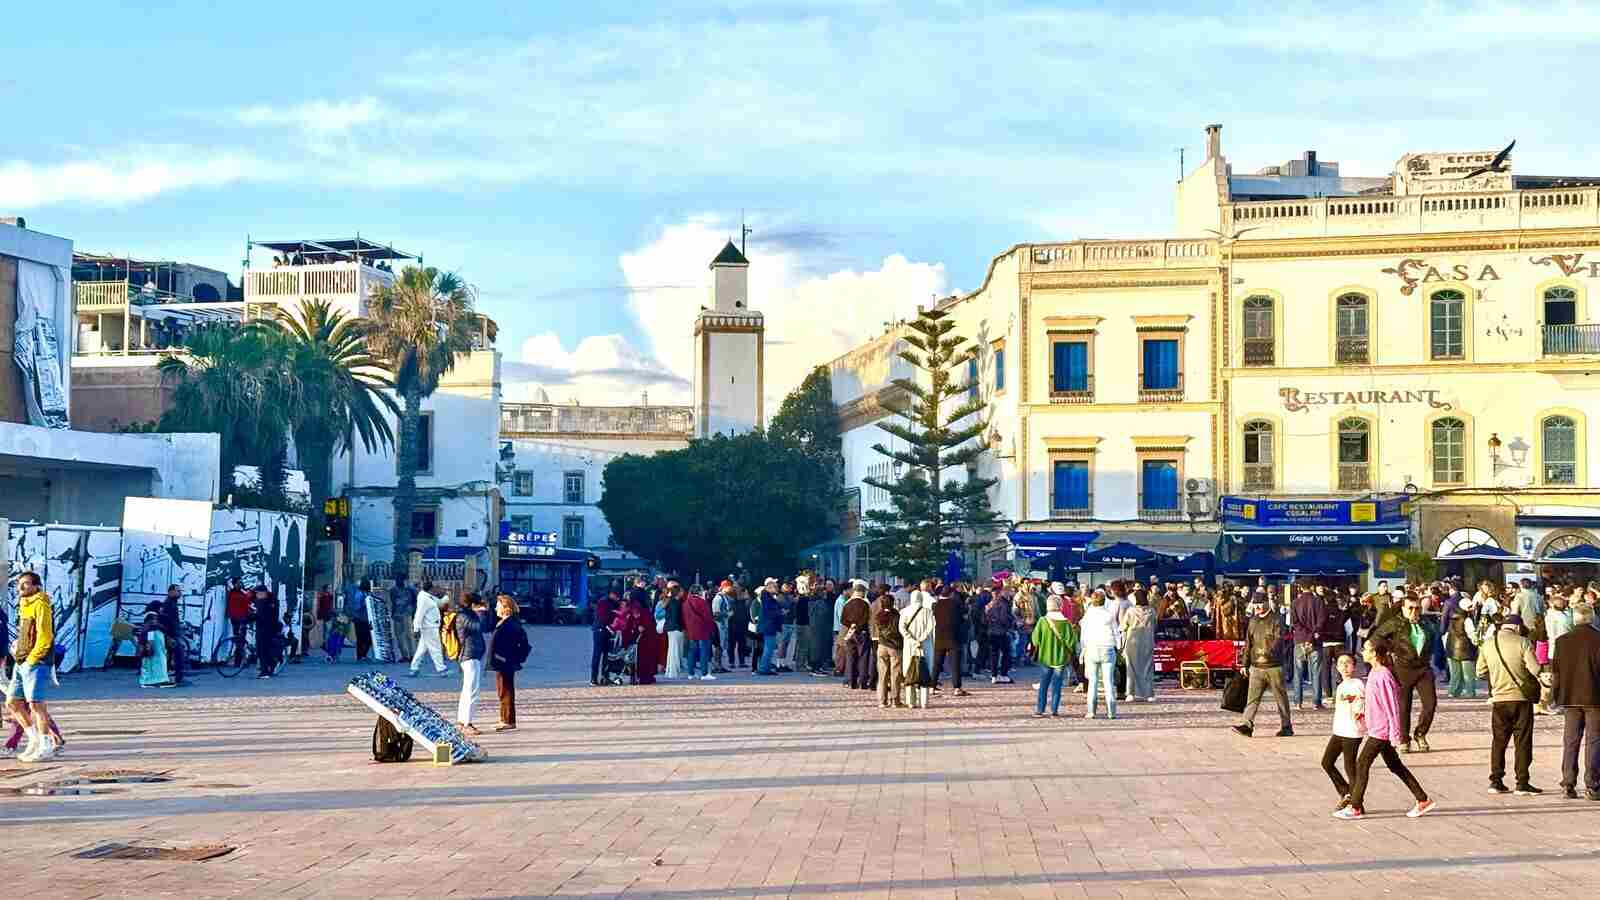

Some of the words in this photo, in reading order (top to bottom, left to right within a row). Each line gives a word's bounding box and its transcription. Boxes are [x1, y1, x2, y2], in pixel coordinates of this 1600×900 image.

[1386, 259, 1501, 291] CASA
[1538, 253, 1600, 278] VE
[1280, 388, 1448, 411] RESTAURANT
[1289, 503, 1340, 511] RESTAURANT
[1315, 535, 1339, 543] VIBES
